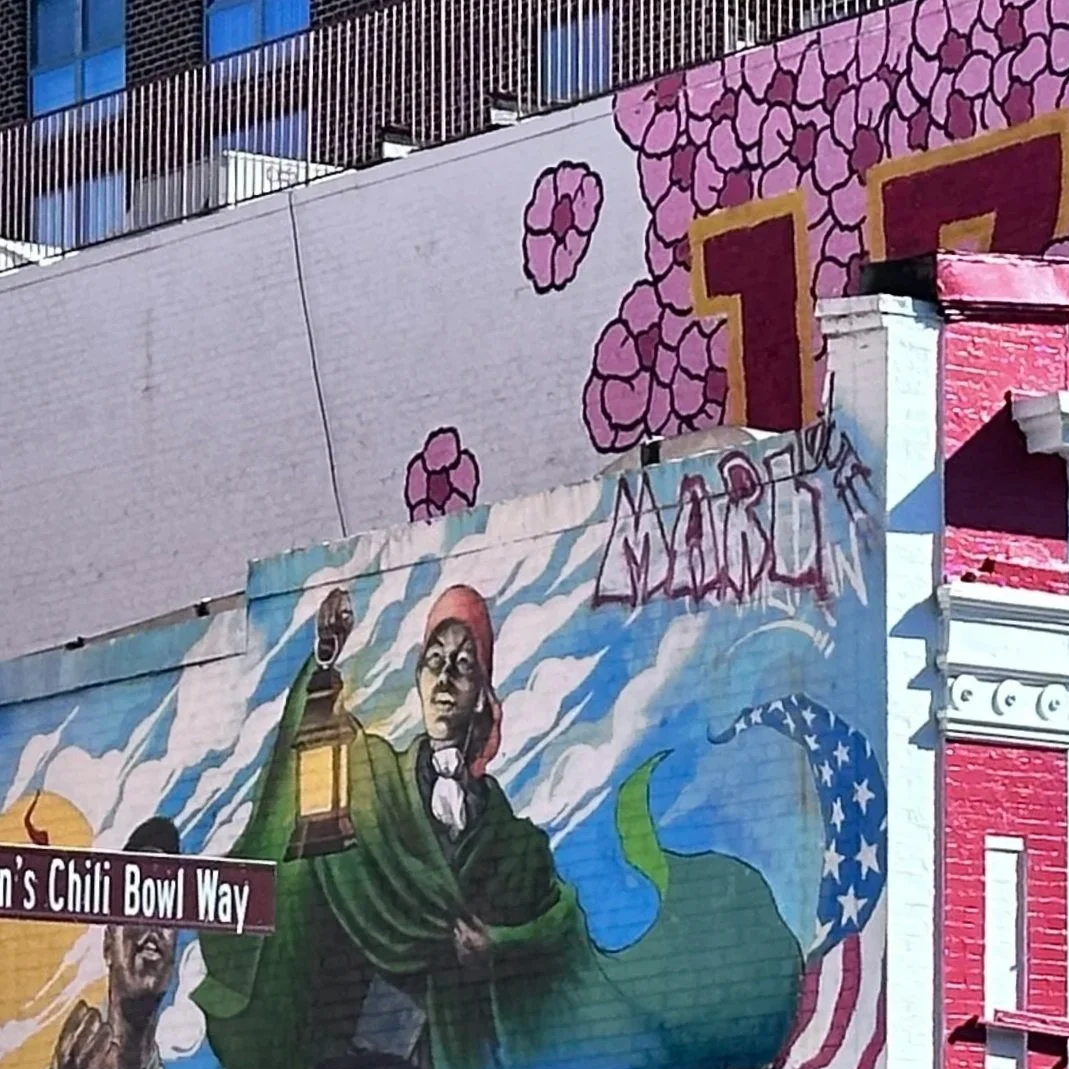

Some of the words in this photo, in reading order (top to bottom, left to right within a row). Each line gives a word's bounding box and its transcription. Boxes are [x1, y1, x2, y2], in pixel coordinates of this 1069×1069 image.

[49, 858, 111, 914] Chili
[124, 864, 184, 919] Bowl
[197, 868, 249, 934] Way
